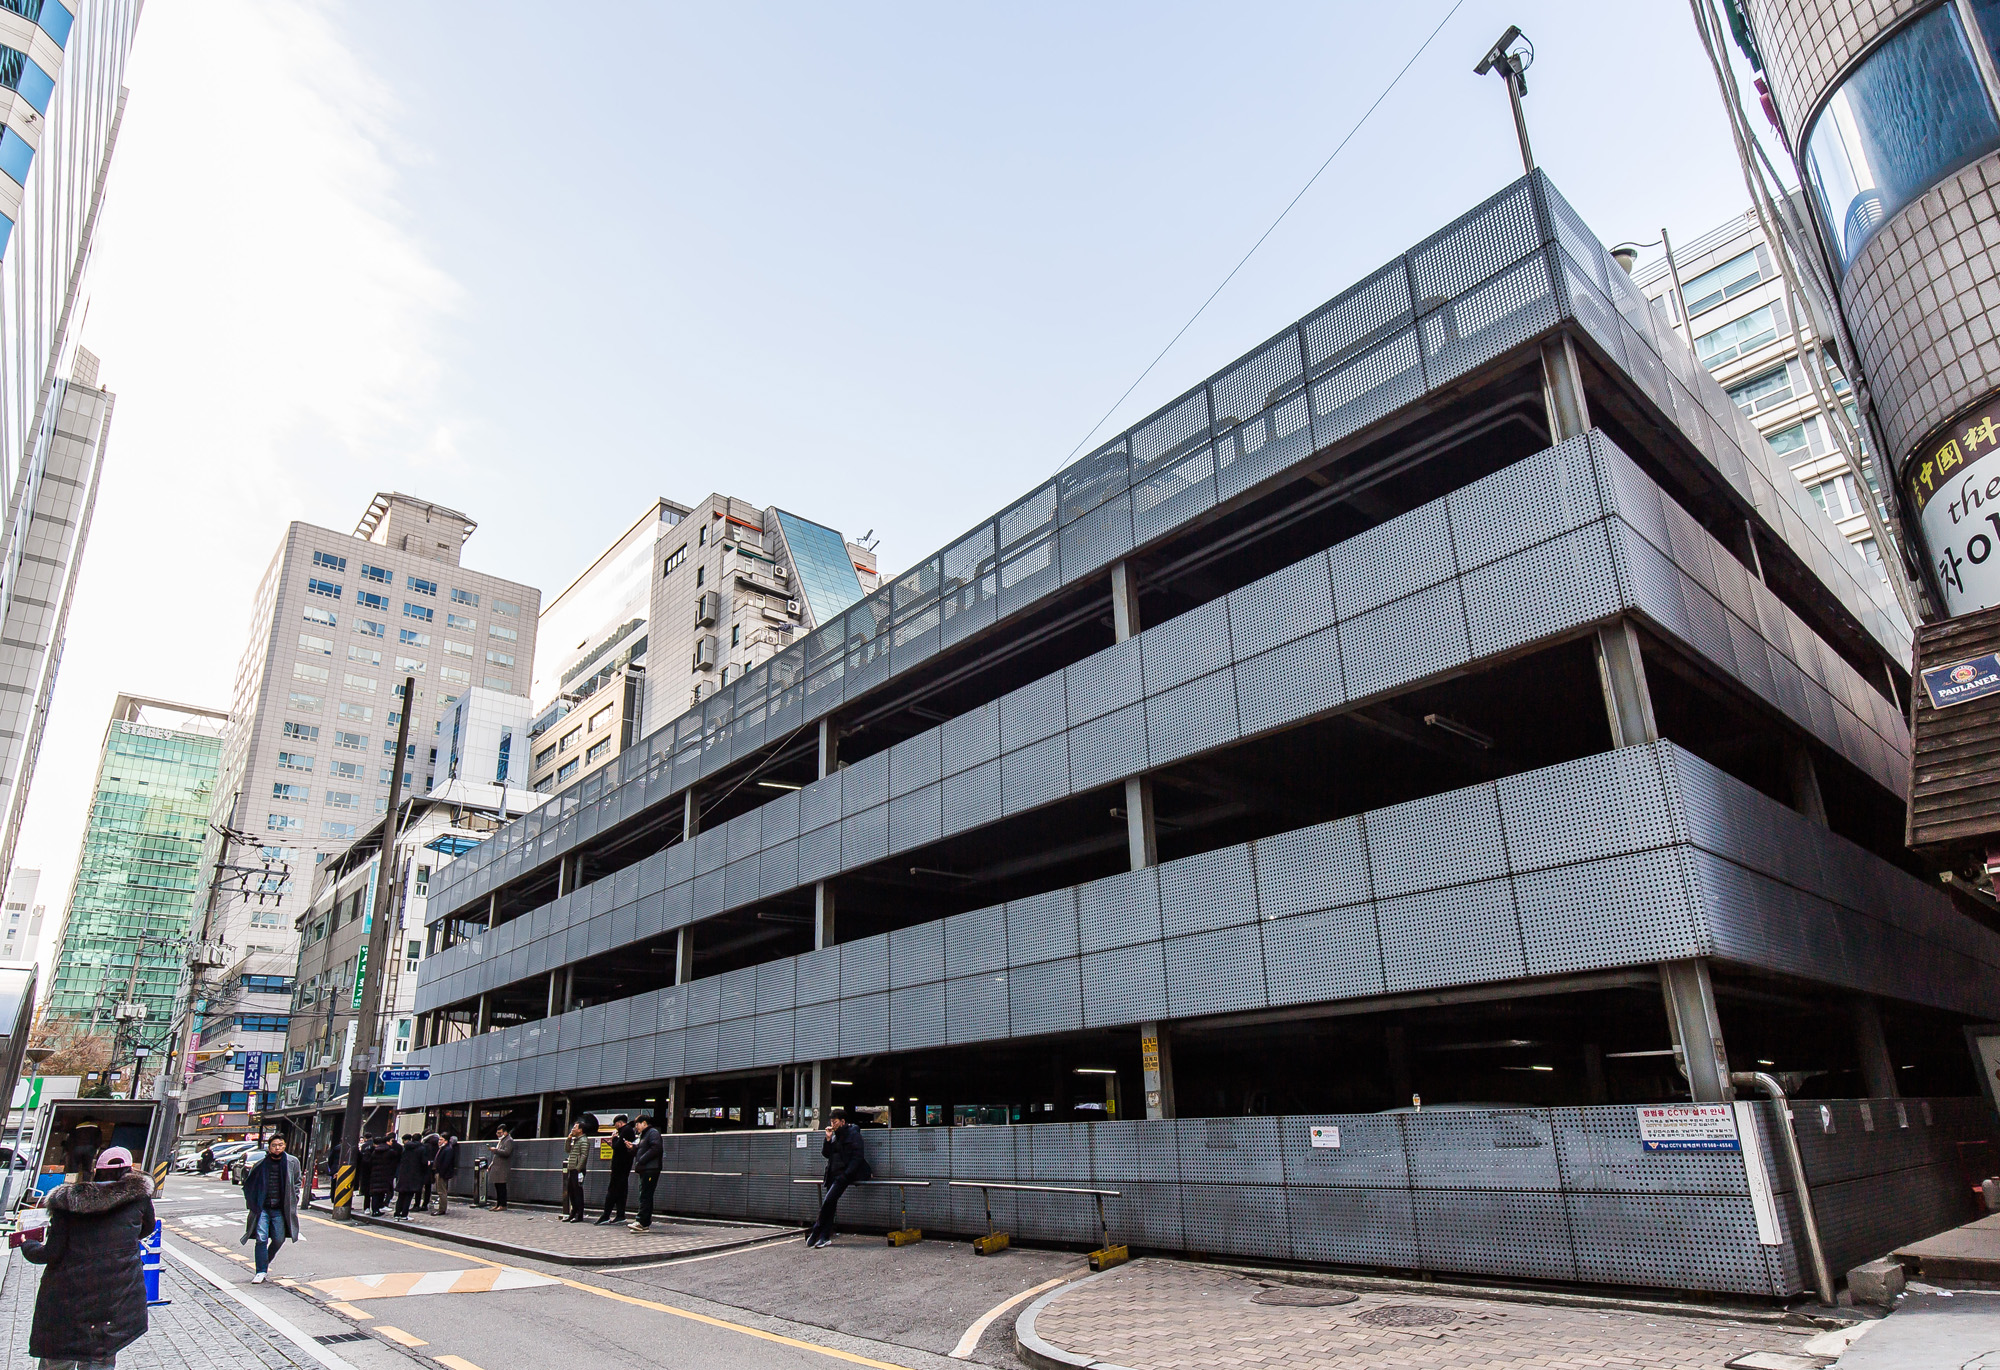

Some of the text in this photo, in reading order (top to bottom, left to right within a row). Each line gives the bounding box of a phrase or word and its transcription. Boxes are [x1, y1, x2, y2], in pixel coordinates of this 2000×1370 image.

[1948, 474, 2000, 524] the
[1938, 674, 2000, 698] PAULANER
[1643, 1109, 1665, 1117] 방범용
[1692, 1108, 1707, 1116] 설치
[1710, 1108, 1726, 1116] 안내
